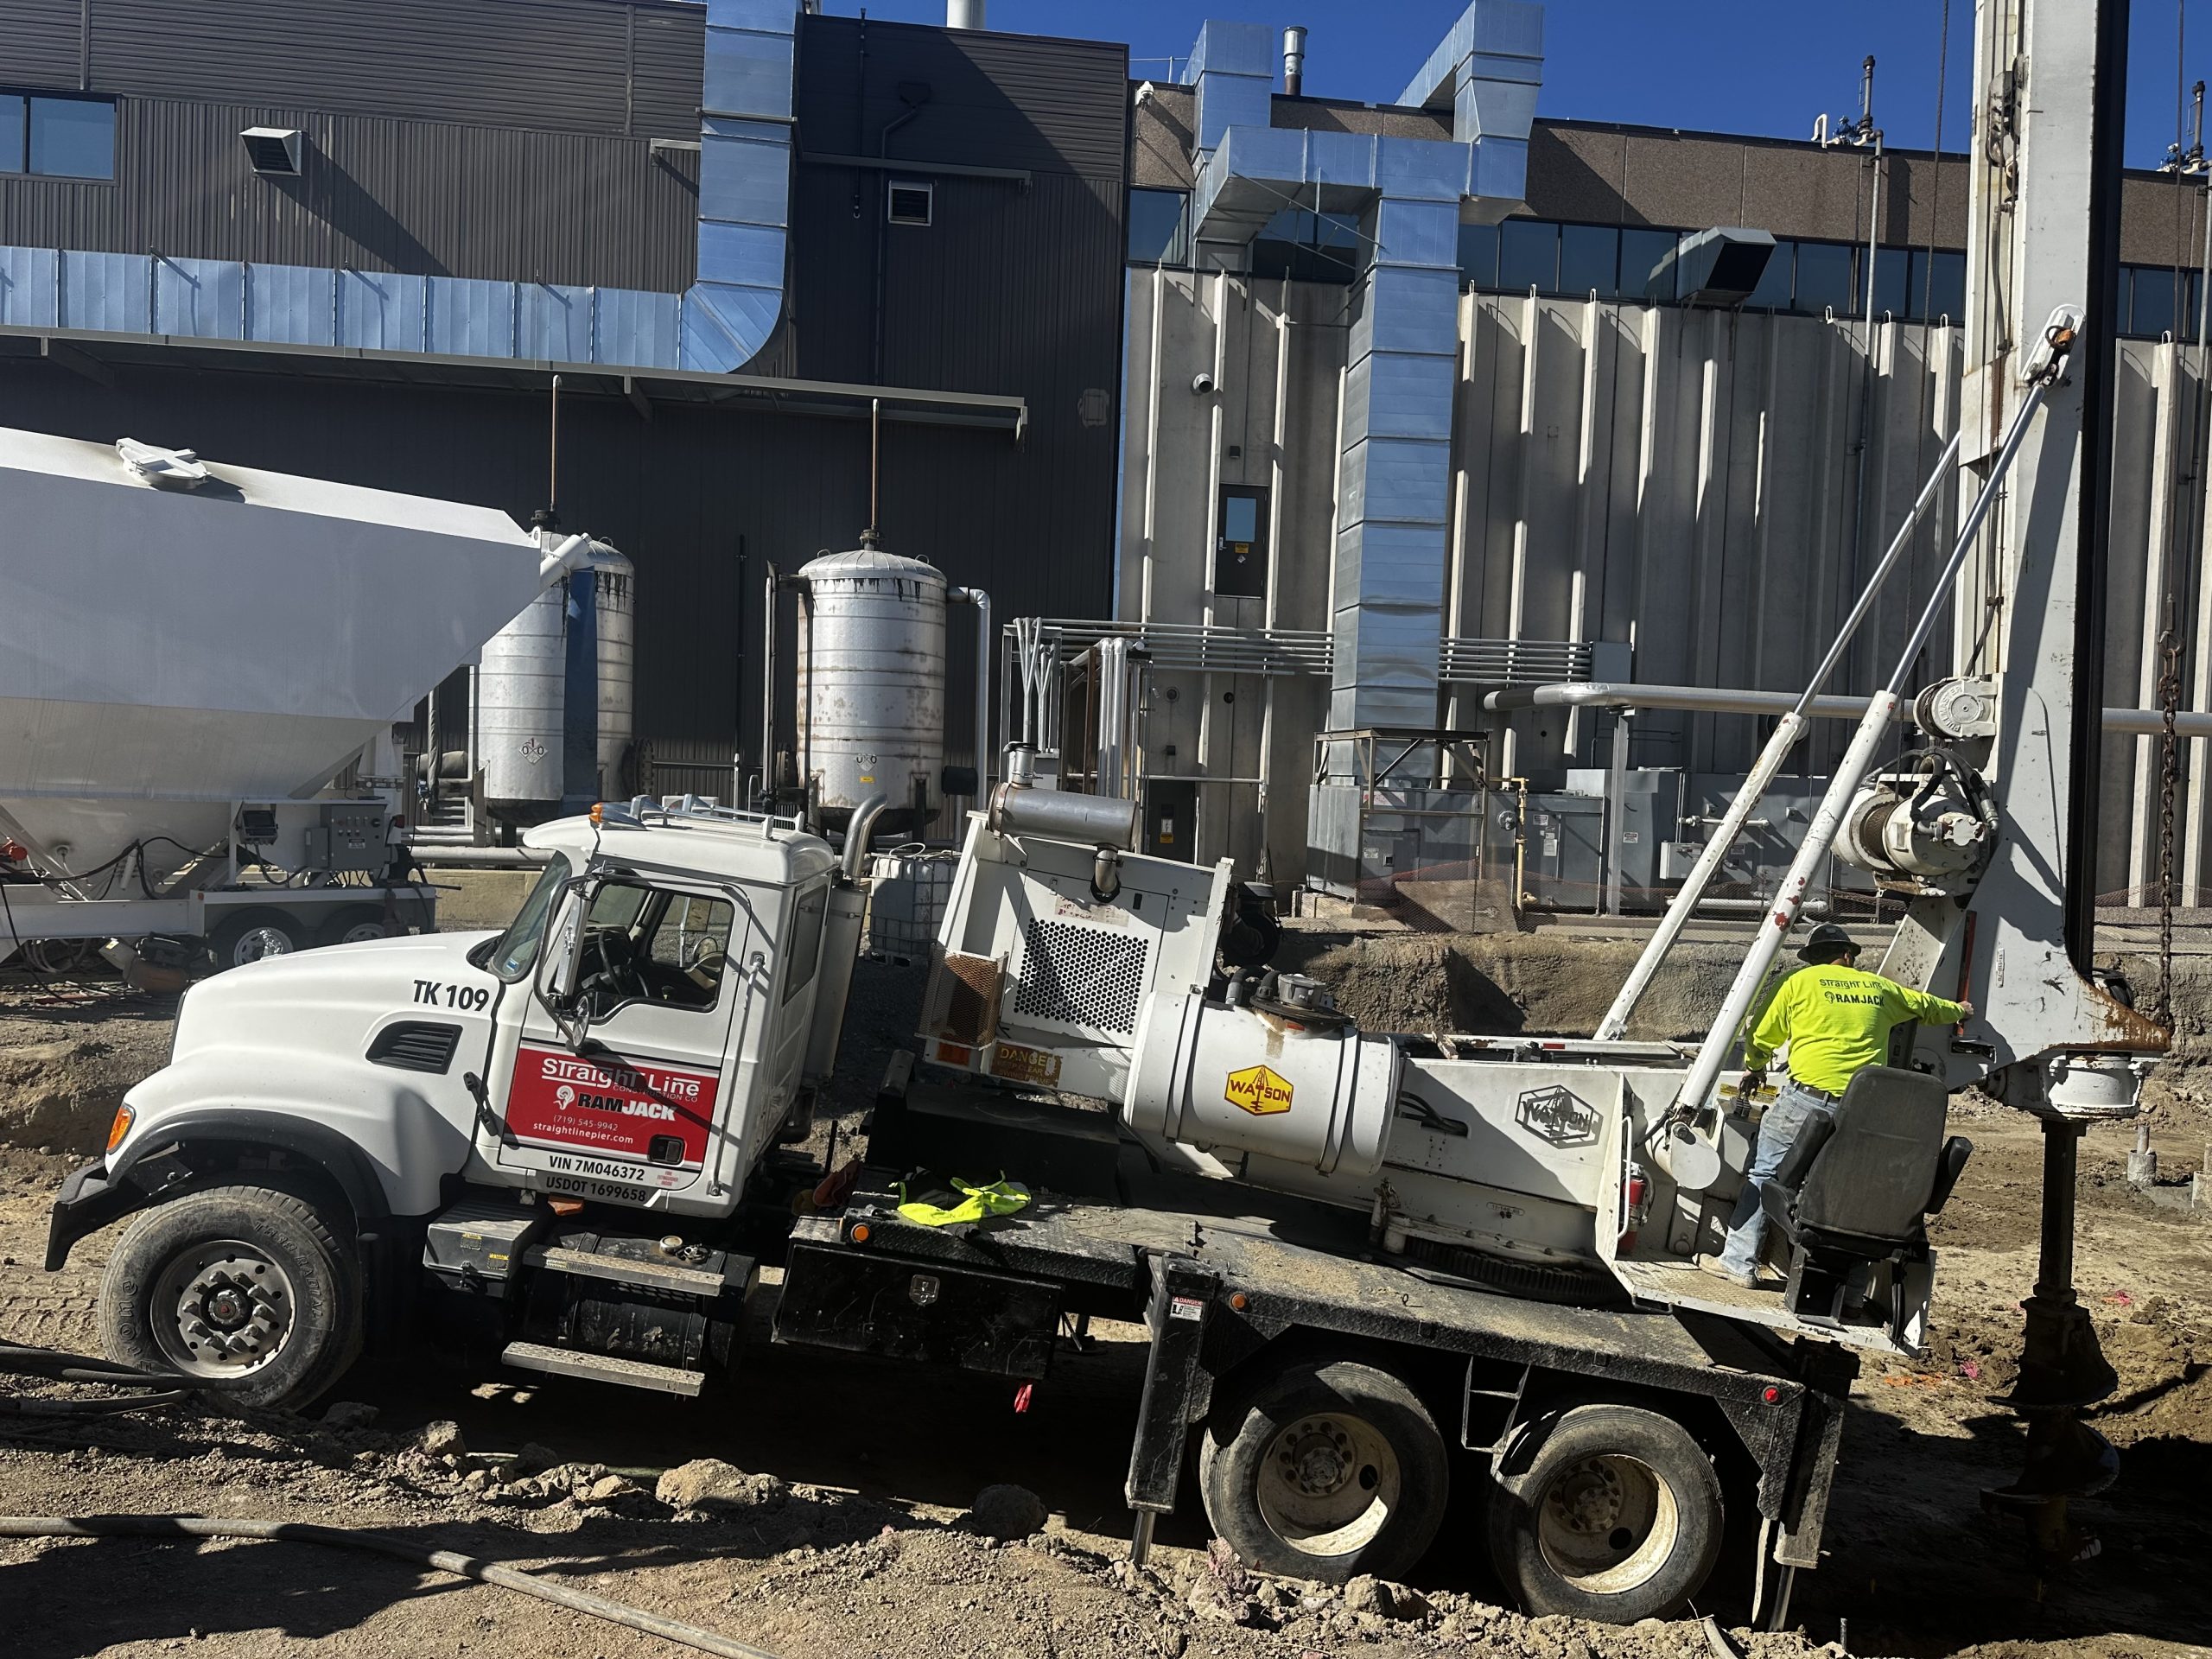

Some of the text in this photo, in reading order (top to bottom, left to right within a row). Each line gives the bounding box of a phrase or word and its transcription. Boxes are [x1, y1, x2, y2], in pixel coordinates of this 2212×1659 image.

[522, 746, 544, 755] 0 0
[414, 979, 490, 1012] TK 109
[1835, 994, 1885, 1007] RAMJACK
[1000, 1047, 1056, 1071] DANGE
[613, 1084, 682, 1102] CONSTRUCTION
[649, 1073, 701, 1096] Line
[1230, 1079, 1291, 1103] WATSON
[533, 1122, 633, 1144] straightlinepier.com
[553, 1115, 619, 1131] (719) 545-9942
[550, 1155, 645, 1181] VIN 7M046372
[546, 1176, 646, 1202] USDOT 1699658
[295, 1255, 323, 1319] RADIAL
